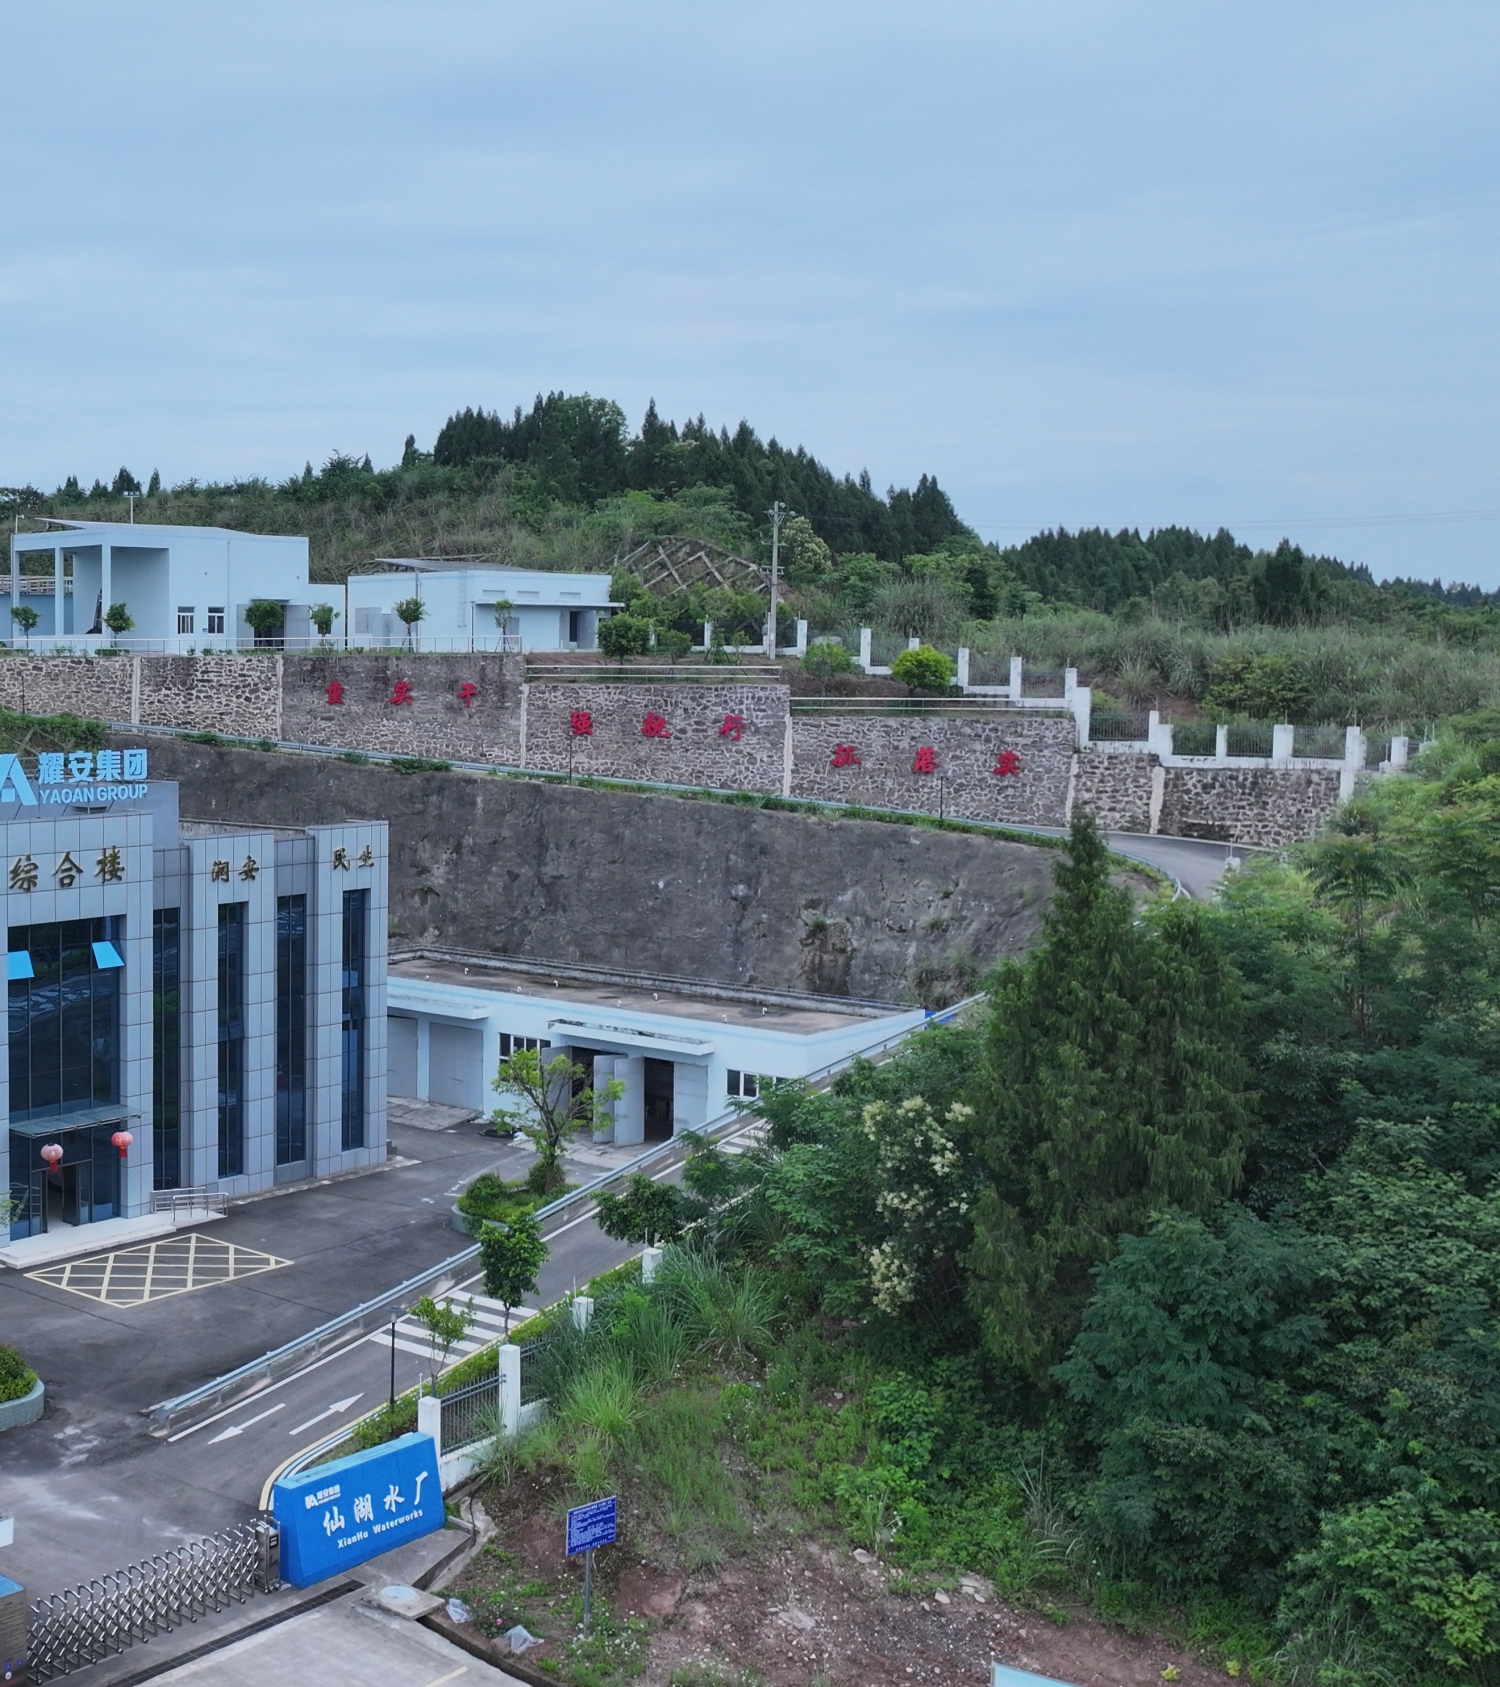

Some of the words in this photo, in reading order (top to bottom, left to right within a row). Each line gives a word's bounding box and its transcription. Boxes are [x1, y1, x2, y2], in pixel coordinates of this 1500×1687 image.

[325, 679, 479, 709] 重实干
[570, 710, 747, 742] 强执行
[831, 742, 1022, 778] 抓落实
[38, 748, 148, 785] 耀安集团
[39, 787, 95, 805] YAOAN
[97, 784, 148, 801] GROUP
[9, 845, 125, 892] 综合楼
[210, 854, 260, 883] 润安
[332, 844, 375, 871] 民生
[323, 1471, 429, 1537] 仙湖水厂
[337, 1530, 369, 1549] XianHu
[372, 1508, 424, 1535] Waterworks
